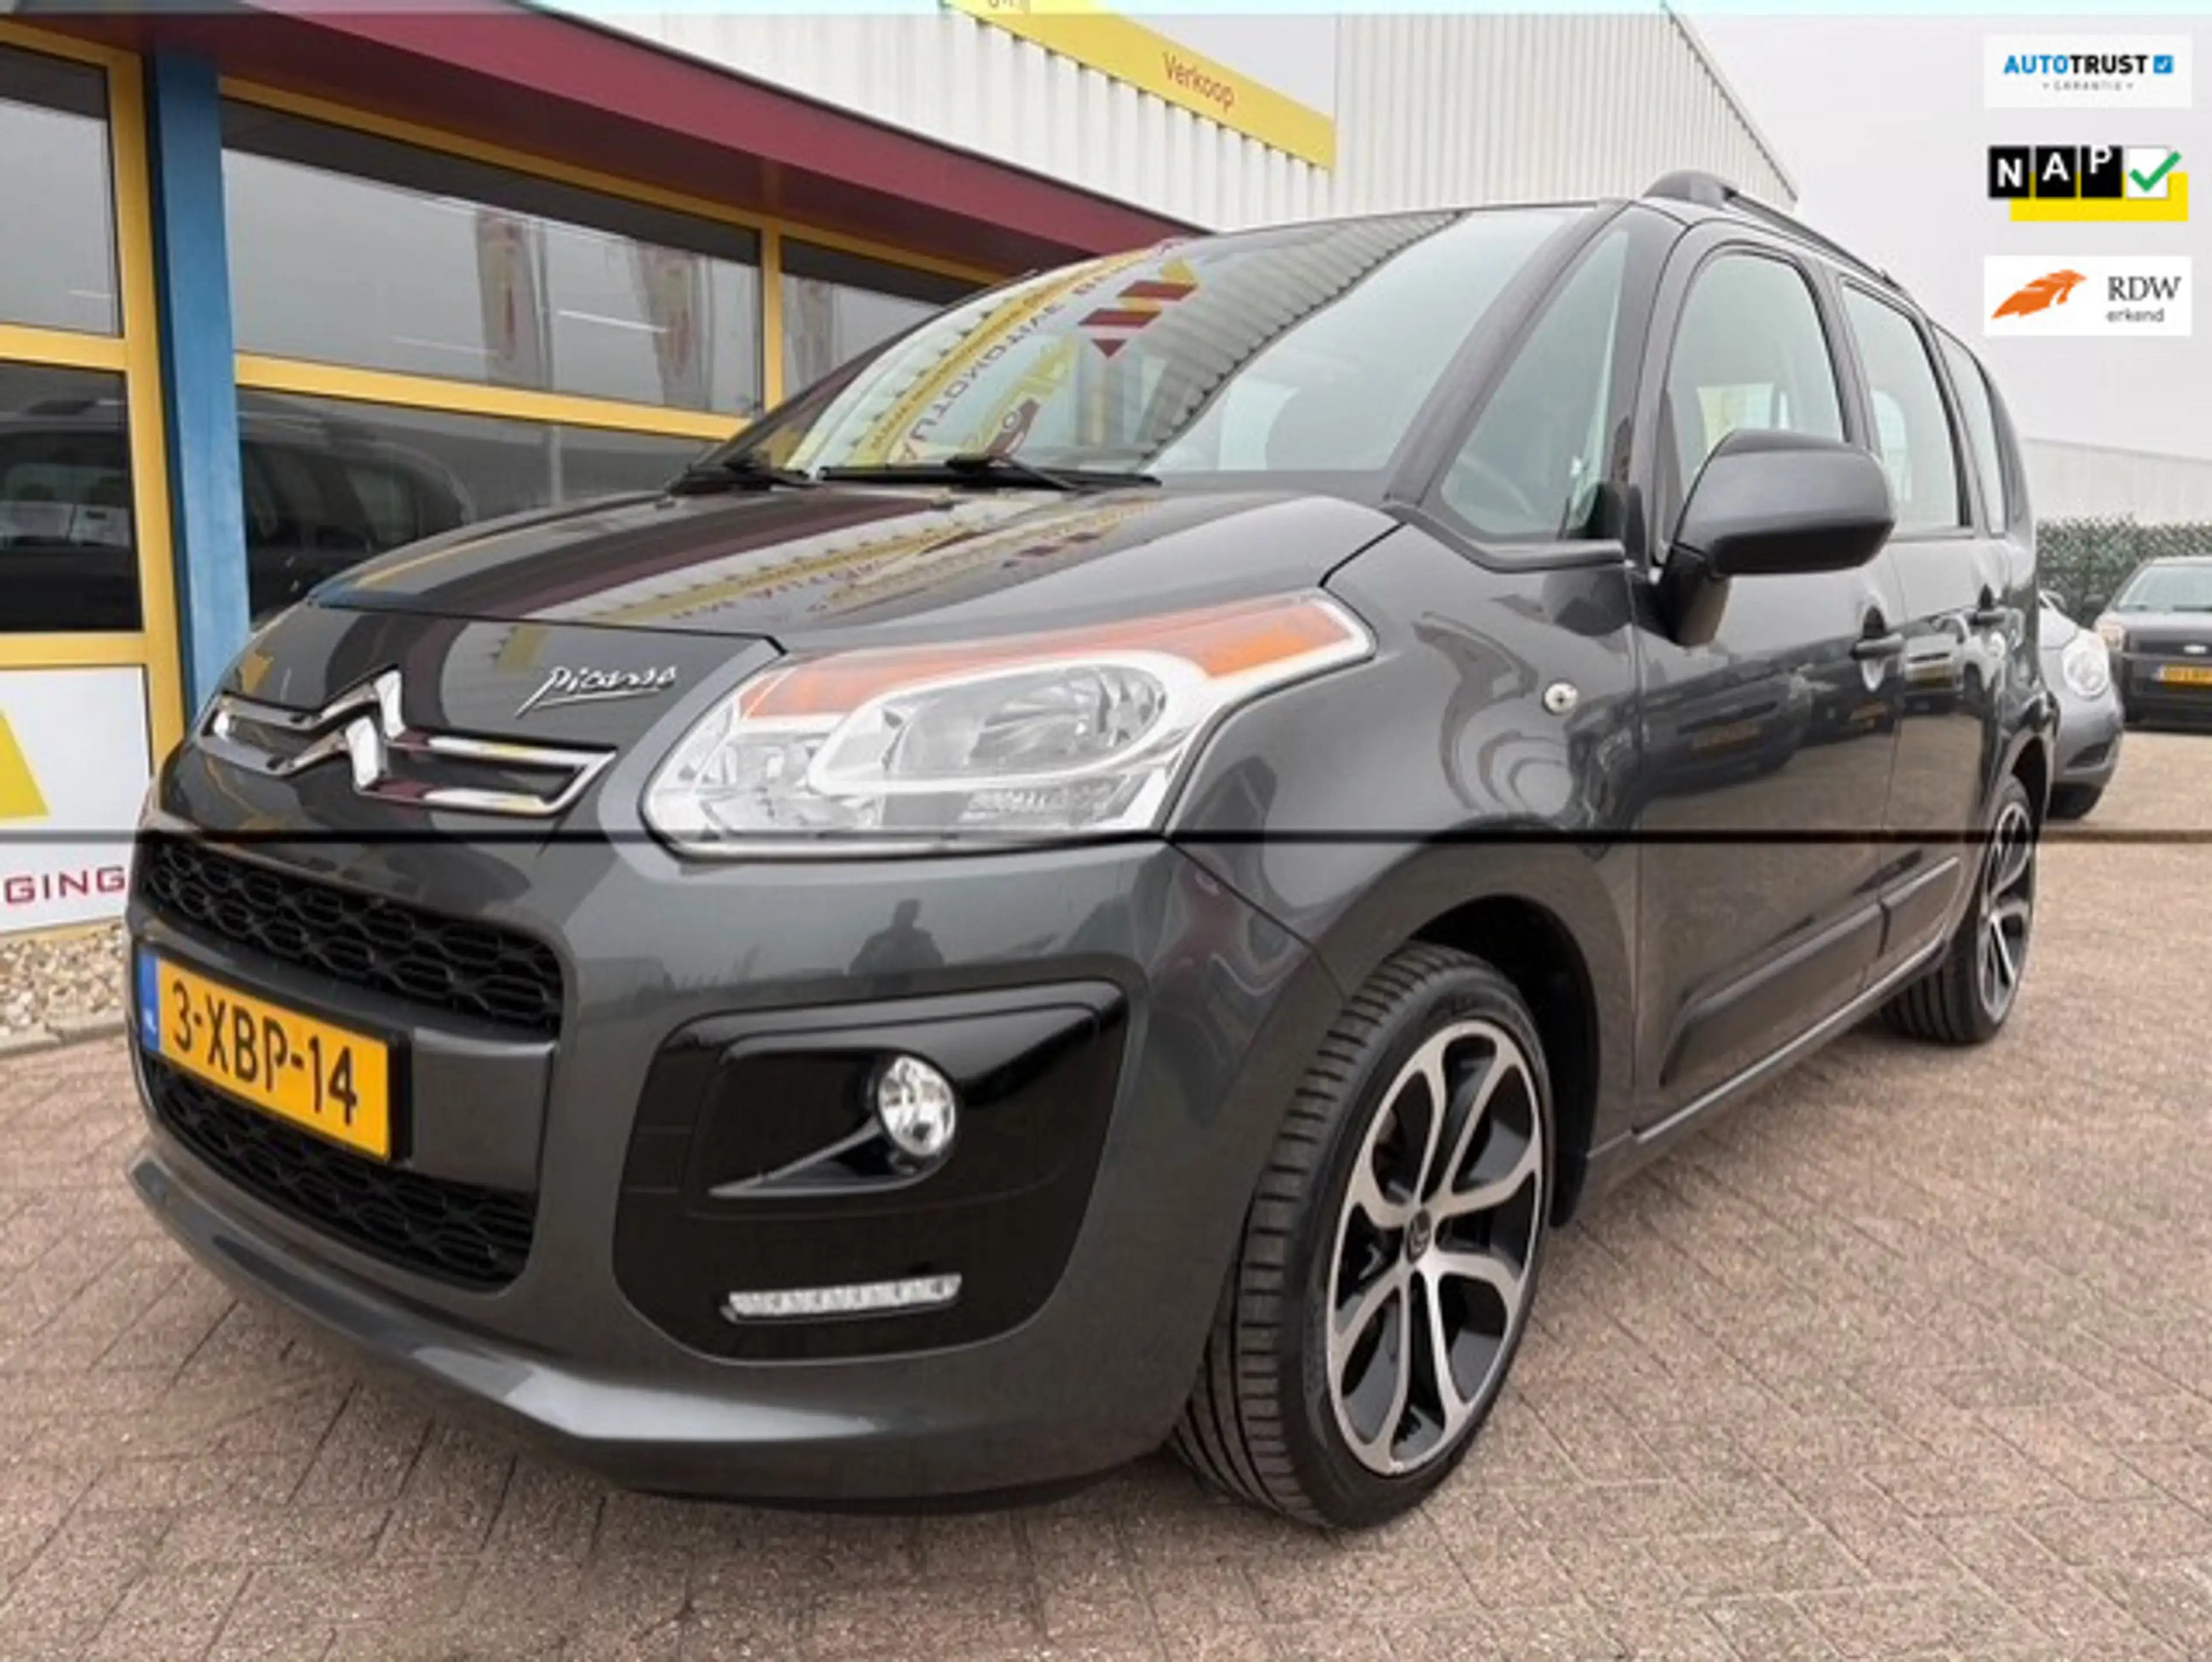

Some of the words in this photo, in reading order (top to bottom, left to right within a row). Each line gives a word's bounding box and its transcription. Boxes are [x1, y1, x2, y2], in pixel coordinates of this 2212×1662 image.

[1161, 50, 1234, 114] Verkoop
[515, 665, 675, 720] Picasso
[173, 979, 358, 1128] 3-XBP-14
